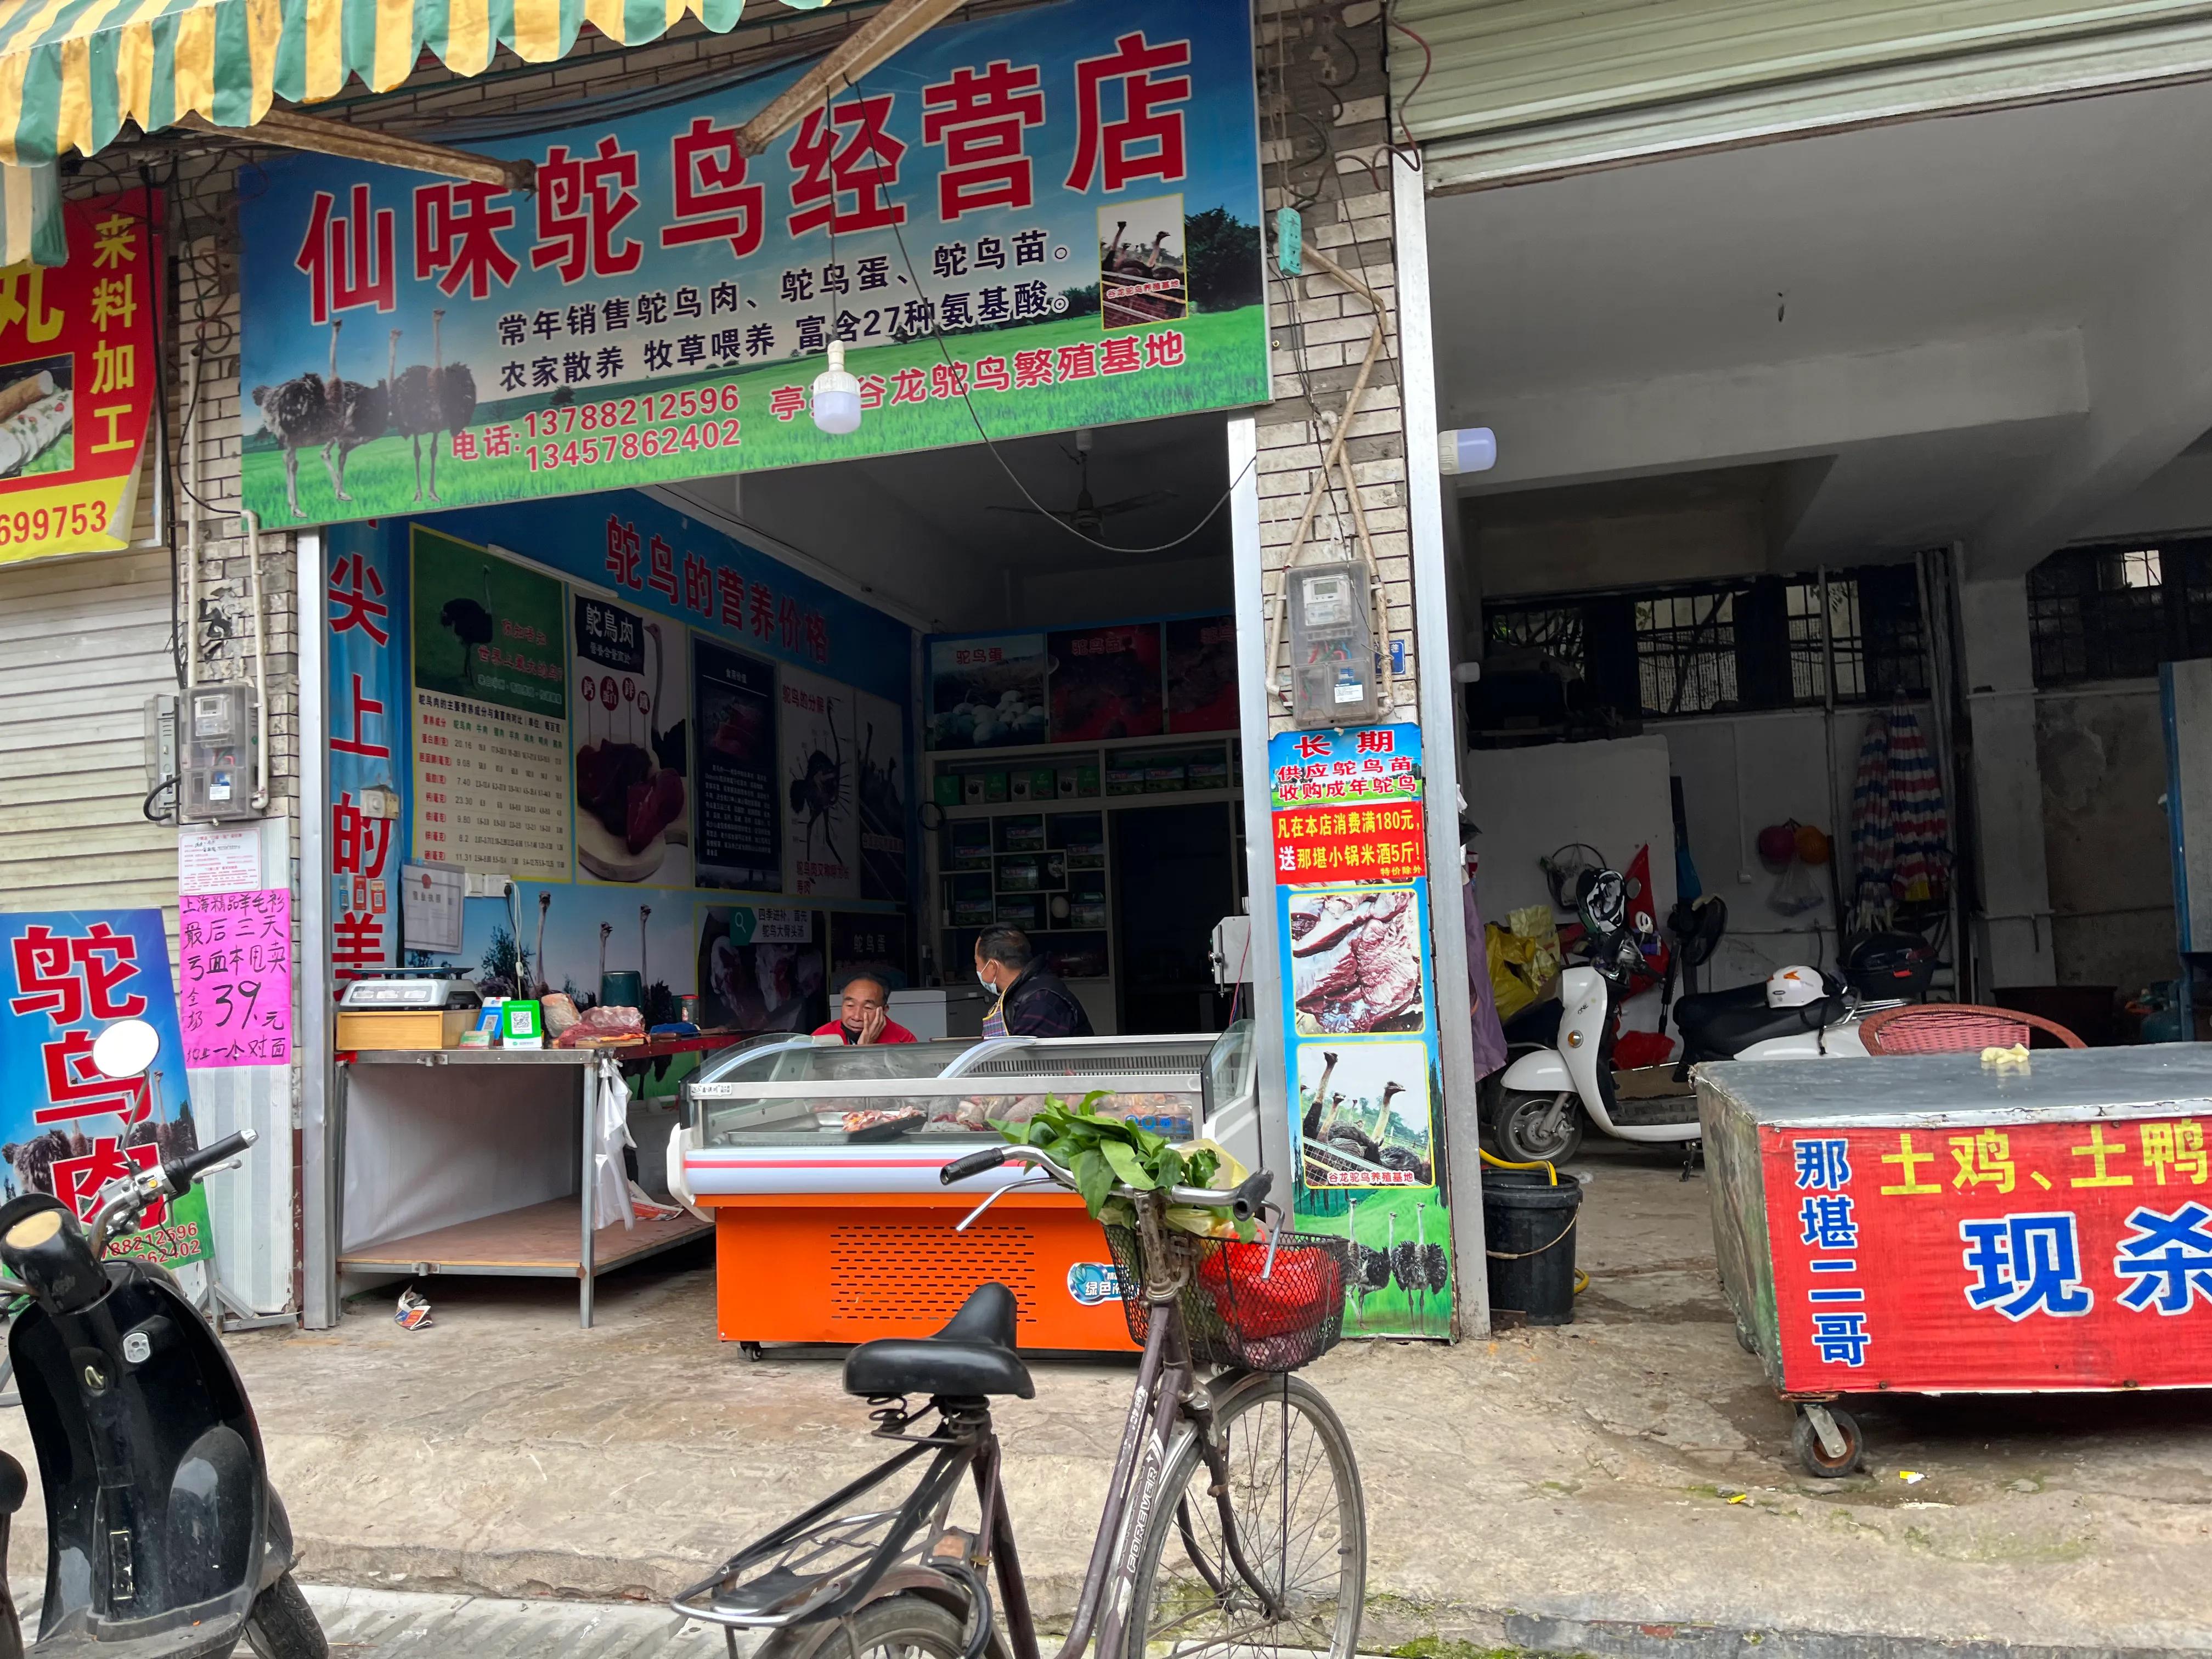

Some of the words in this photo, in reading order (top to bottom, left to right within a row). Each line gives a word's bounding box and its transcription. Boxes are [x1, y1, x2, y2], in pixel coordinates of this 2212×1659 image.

[295, 30, 1190, 325] 仙味鸵鸟经营店
[91, 214, 137, 454] 来料加工
[499, 346, 624, 393] 农家散养
[643, 324, 775, 372] 牧草喂养
[523, 383, 740, 439] 13788212596
[769, 330, 1185, 421] 亭谷龙鸵鸟繁殖基地
[526, 419, 741, 472] 13457862402
[328, 518, 390, 1001] 尖上的美
[1277, 756, 1413, 781] 供应鸵鸟苗
[1293, 730, 1396, 759] 长期
[1279, 774, 1417, 802] 收购成年鸵鸟
[184, 915, 284, 950] 最后三天
[9, 921, 170, 1231] 鸵鸟肉
[1880, 1119, 2209, 1196] 土鸡、土鸭
[1792, 1138, 1871, 1368] 那堪二哥
